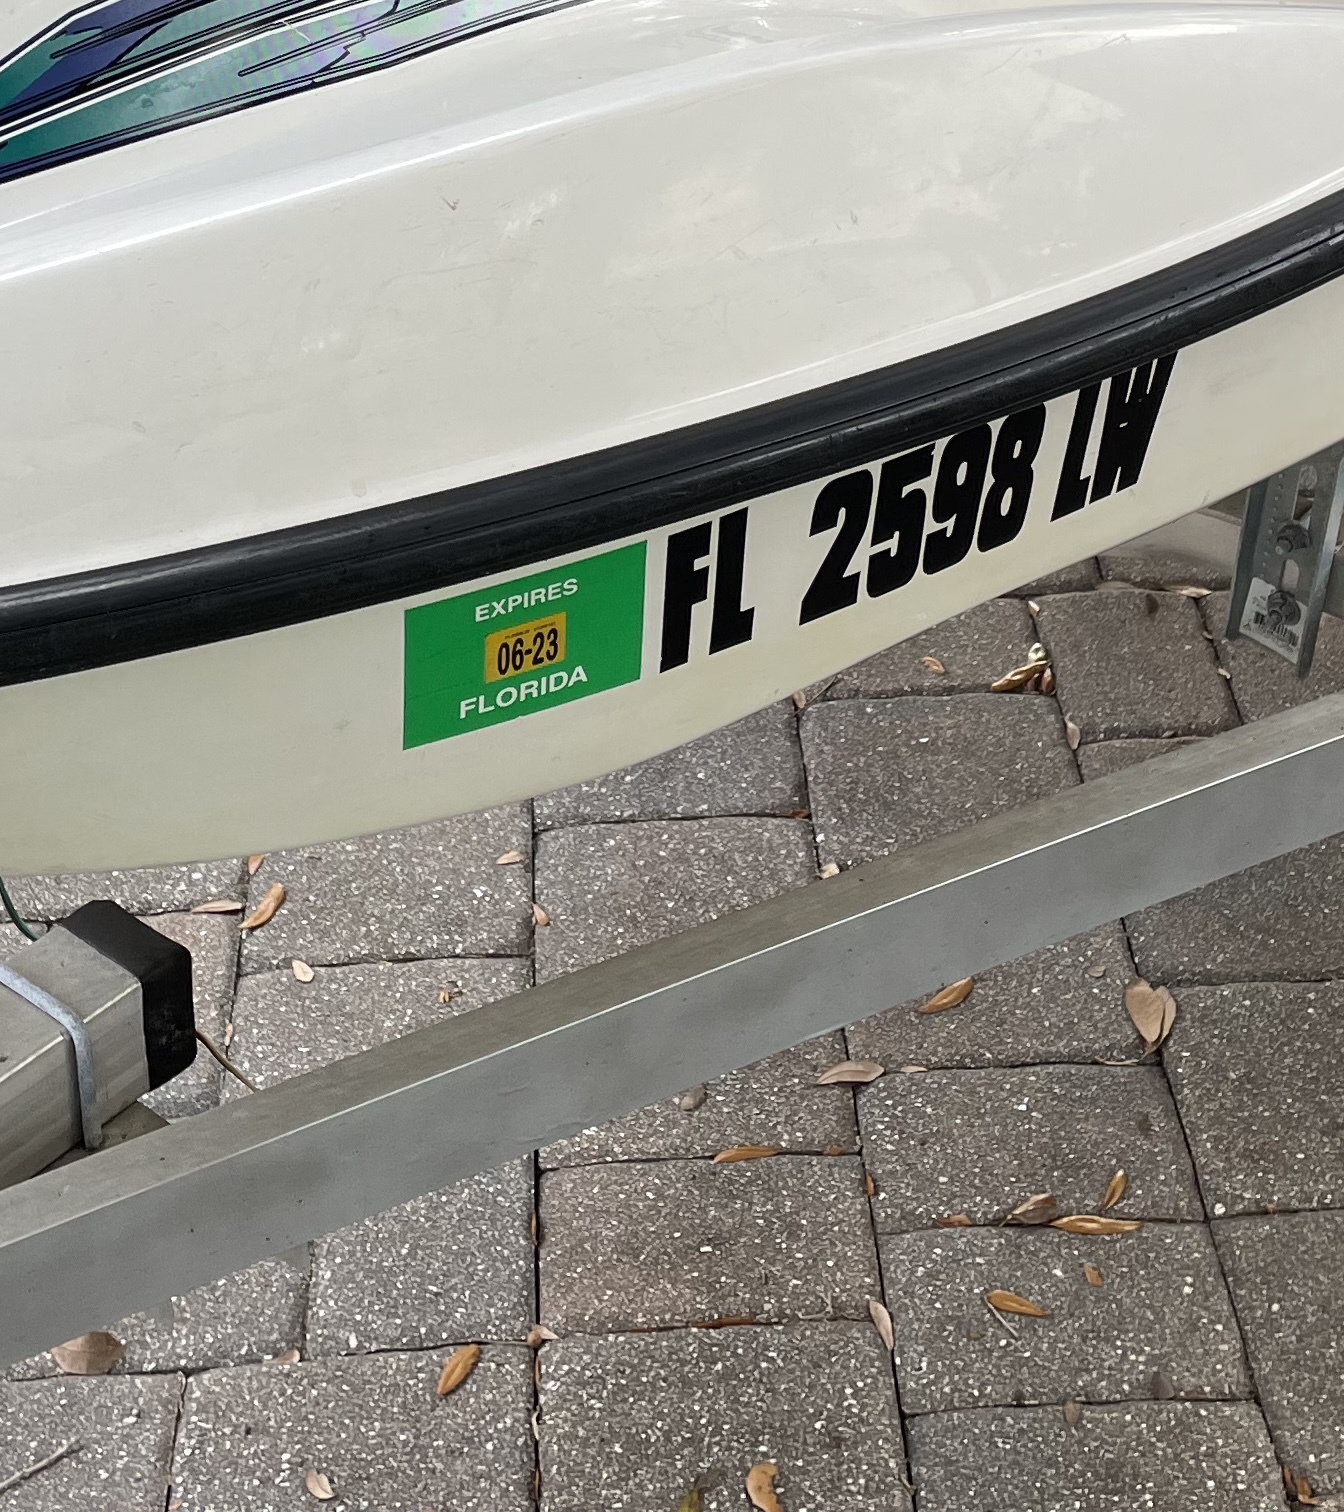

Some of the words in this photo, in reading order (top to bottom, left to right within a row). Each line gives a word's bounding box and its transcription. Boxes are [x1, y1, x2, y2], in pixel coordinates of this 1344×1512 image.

[660, 506, 755, 674] FL
[799, 401, 1047, 626] 2598
[1051, 350, 1178, 524] LW
[475, 578, 579, 623] EXPIRES
[497, 627, 558, 675] 06-23
[459, 665, 588, 719] FLORIDA
